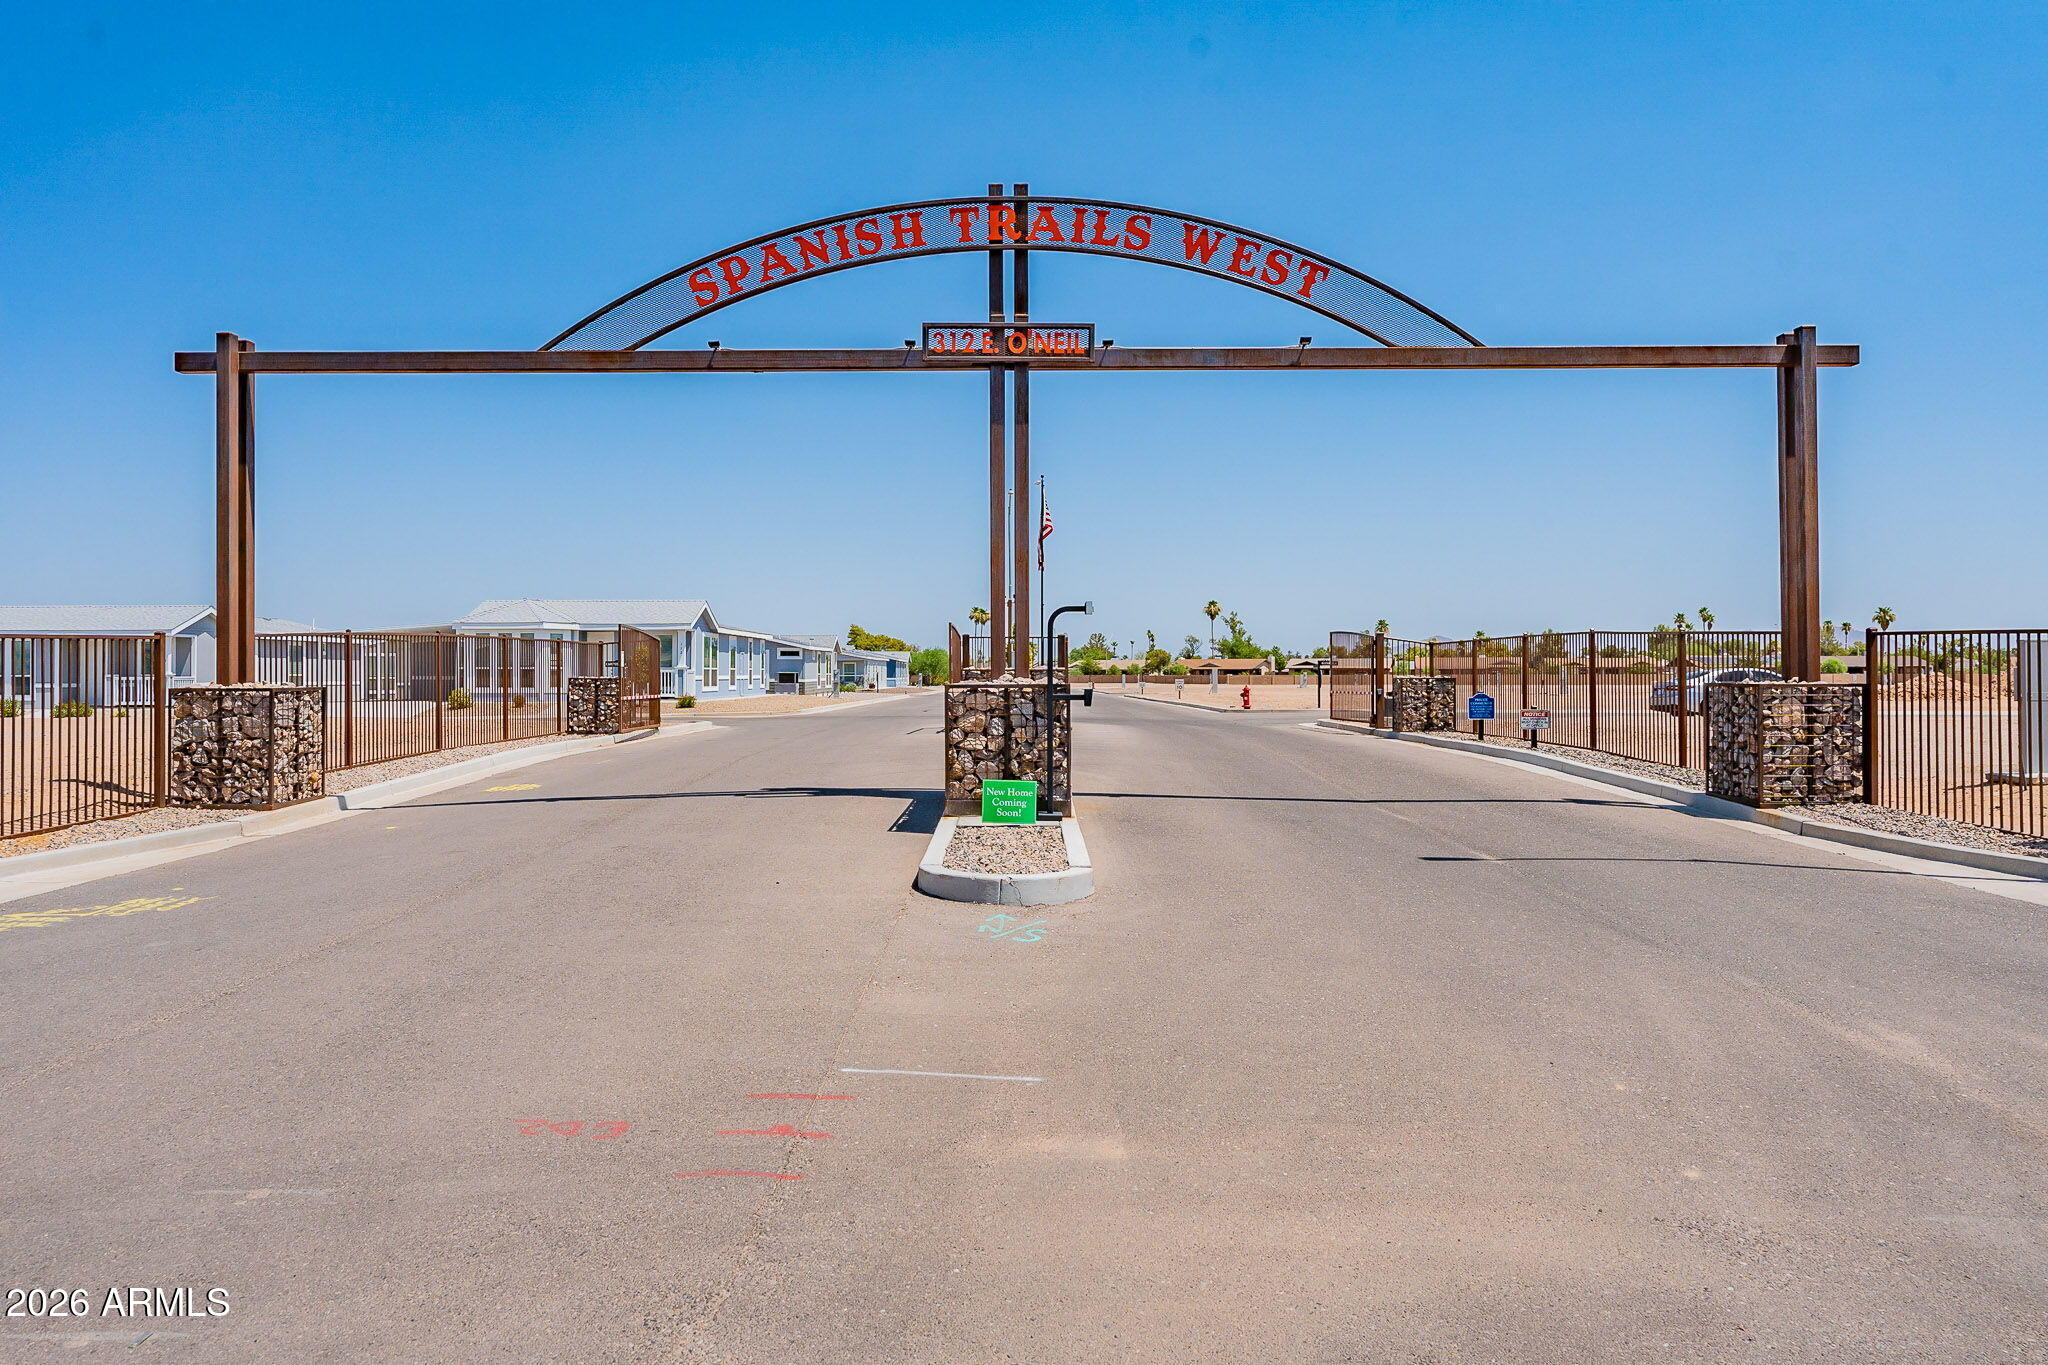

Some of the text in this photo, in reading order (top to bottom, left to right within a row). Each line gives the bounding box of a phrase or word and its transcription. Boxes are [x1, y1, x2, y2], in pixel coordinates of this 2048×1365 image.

[688, 204, 1331, 307] SPANISH TRAILS WEST
[932, 329, 1085, 354] 312 E. O'NEIL
[986, 787, 1034, 797] New Home
[991, 797, 1027, 809] Coming
[996, 807, 1022, 817] Soon!
